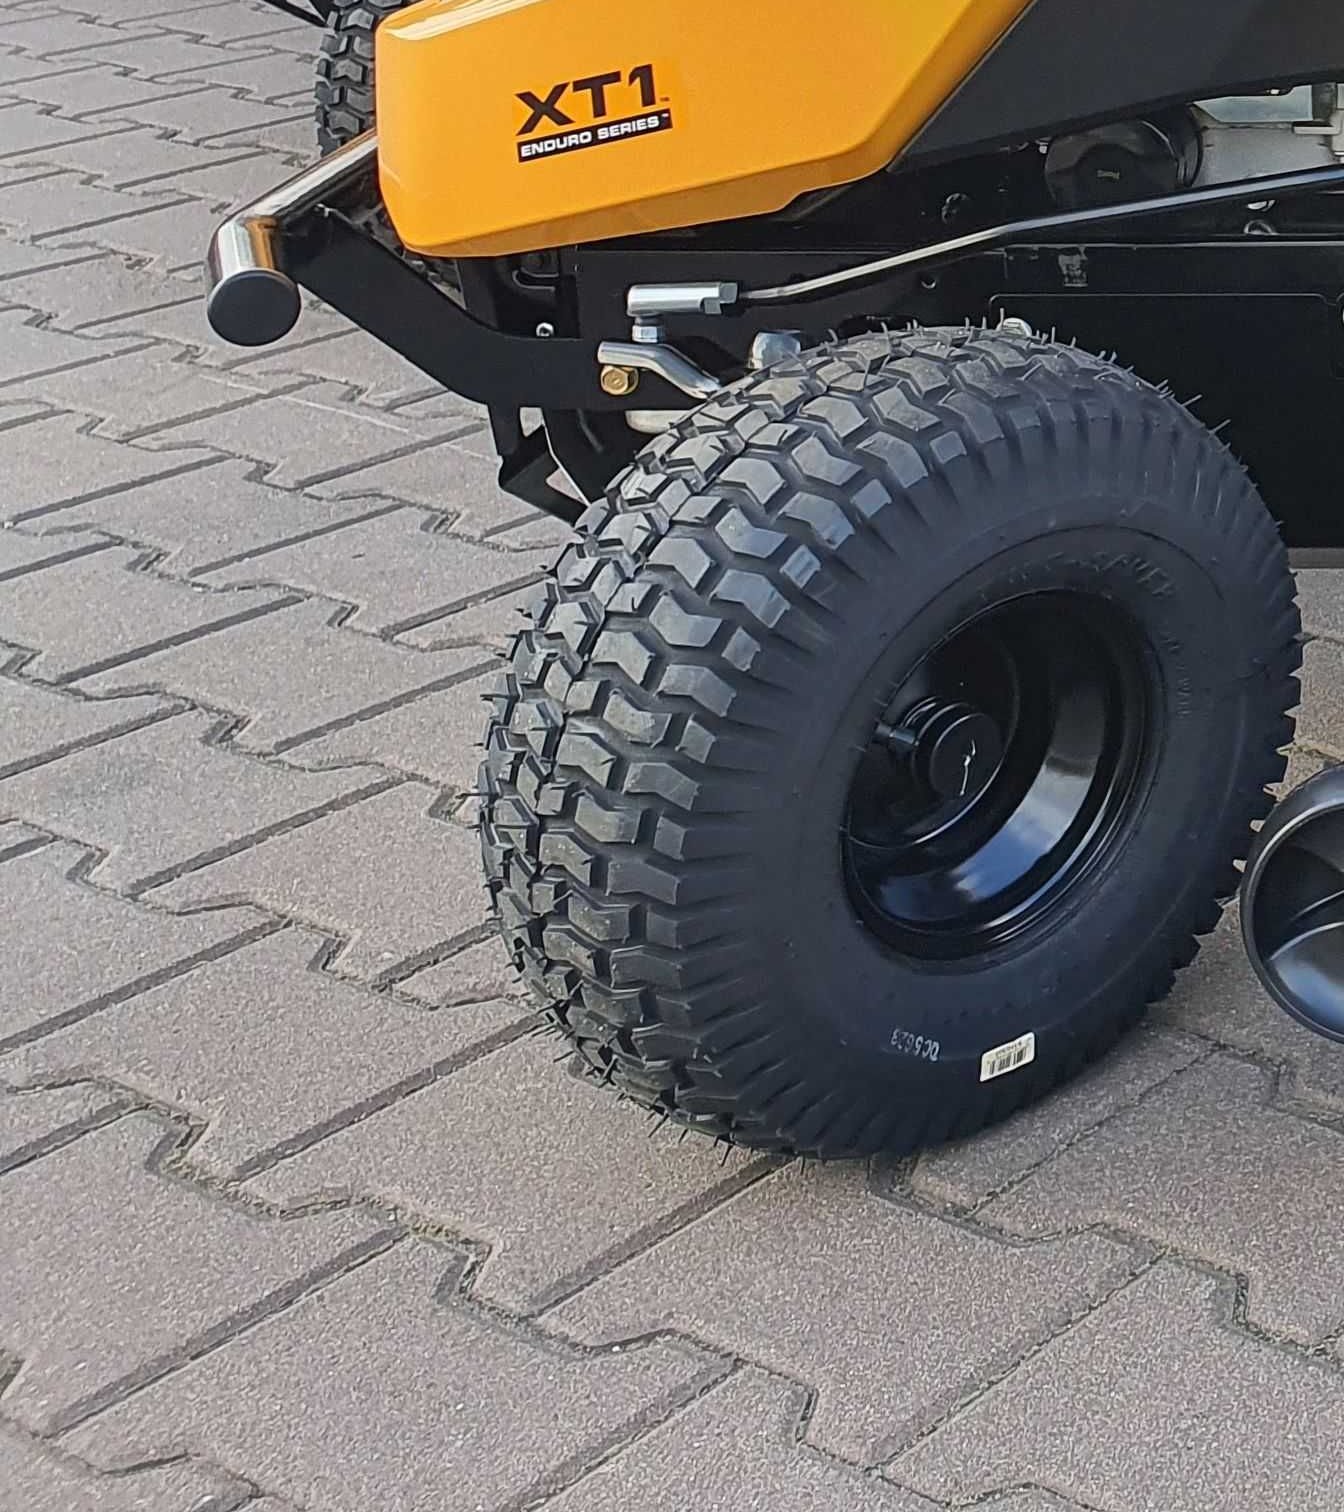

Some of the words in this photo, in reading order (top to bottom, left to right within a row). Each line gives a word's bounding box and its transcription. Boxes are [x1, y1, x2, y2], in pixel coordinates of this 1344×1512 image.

[515, 64, 656, 136] XT1
[520, 131, 592, 157] ENDURO
[597, 116, 659, 139] SERIES
